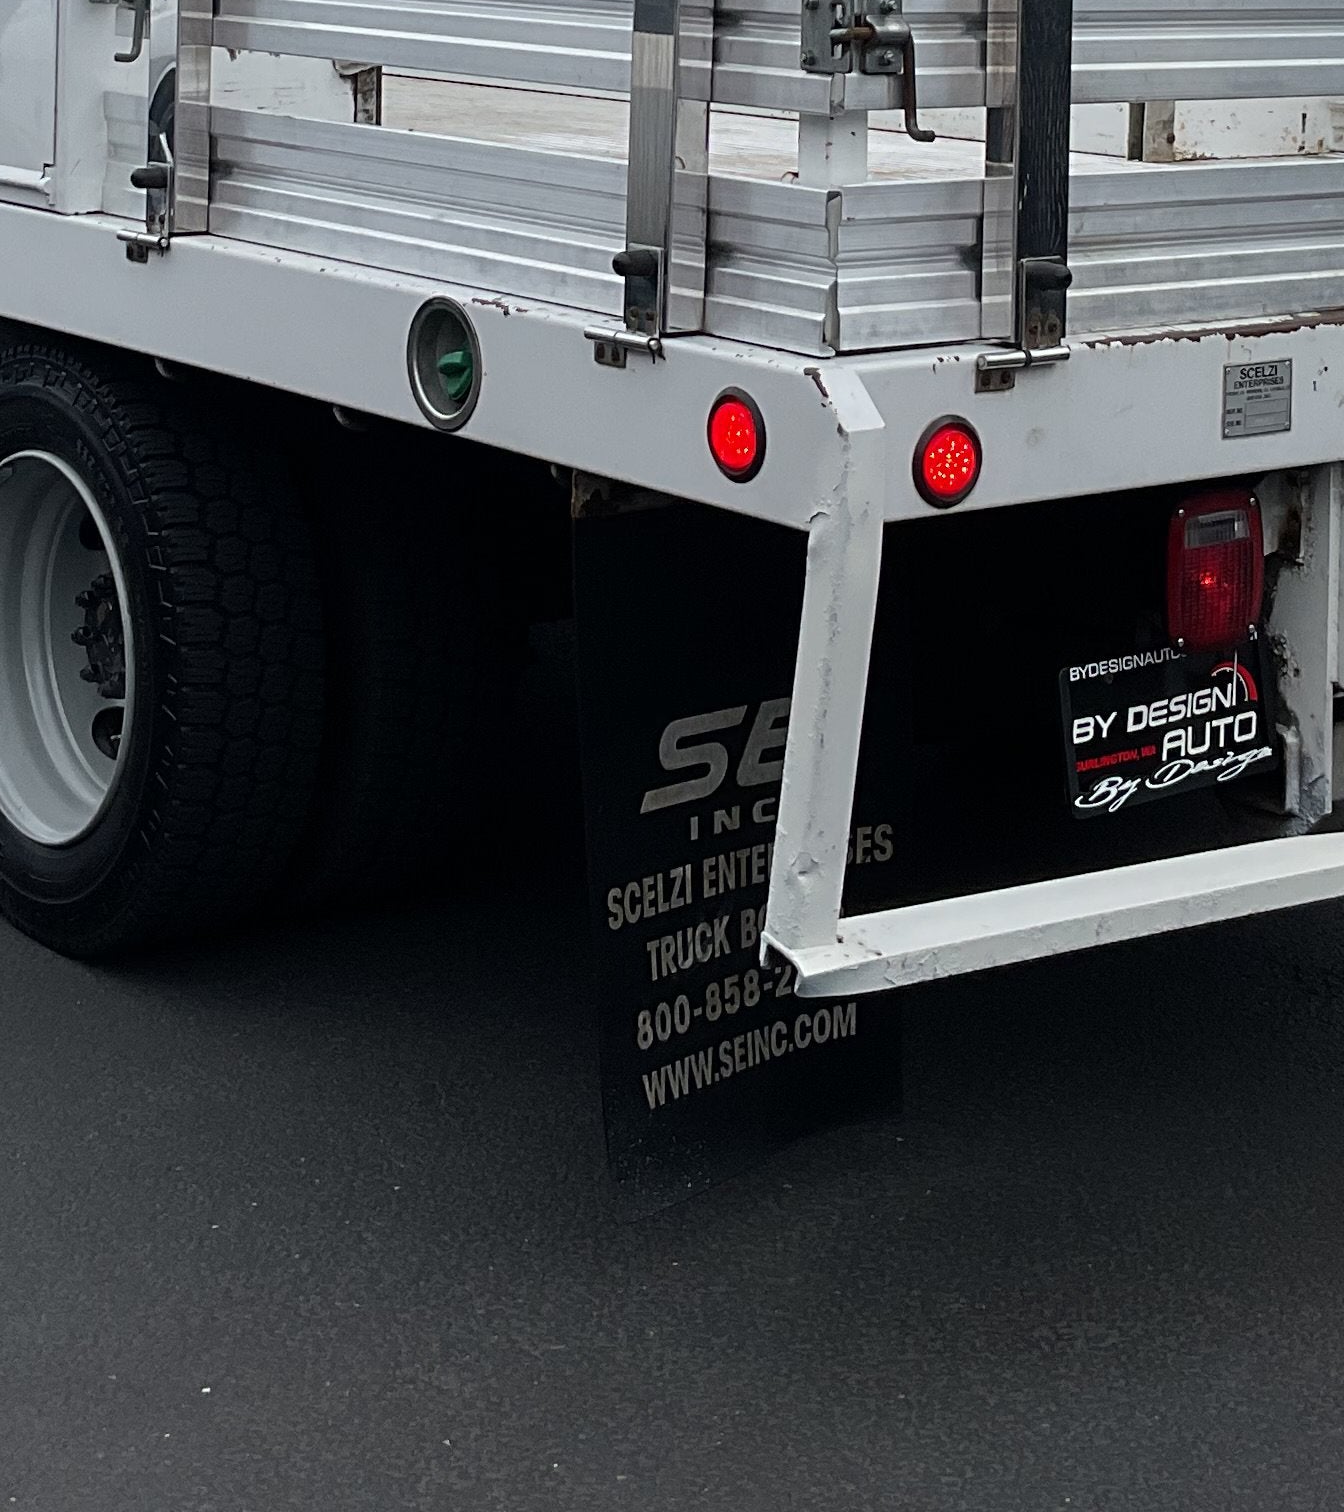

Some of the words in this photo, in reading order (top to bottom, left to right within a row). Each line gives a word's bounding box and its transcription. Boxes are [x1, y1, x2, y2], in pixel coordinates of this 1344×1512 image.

[1233, 376, 1284, 390] ENTERPRISES
[1240, 364, 1277, 380] SCELZI
[1072, 711, 1118, 745] BY
[1126, 683, 1233, 733] DESIGN
[1162, 711, 1257, 762] AUTO
[1074, 776, 1142, 813] By
[1145, 746, 1273, 789] Design
[690, 797, 776, 841] INC
[607, 864, 692, 930] SCELZI
[646, 915, 731, 982] TRUCK
[642, 1002, 857, 1110] WWW.SEINC.COM
